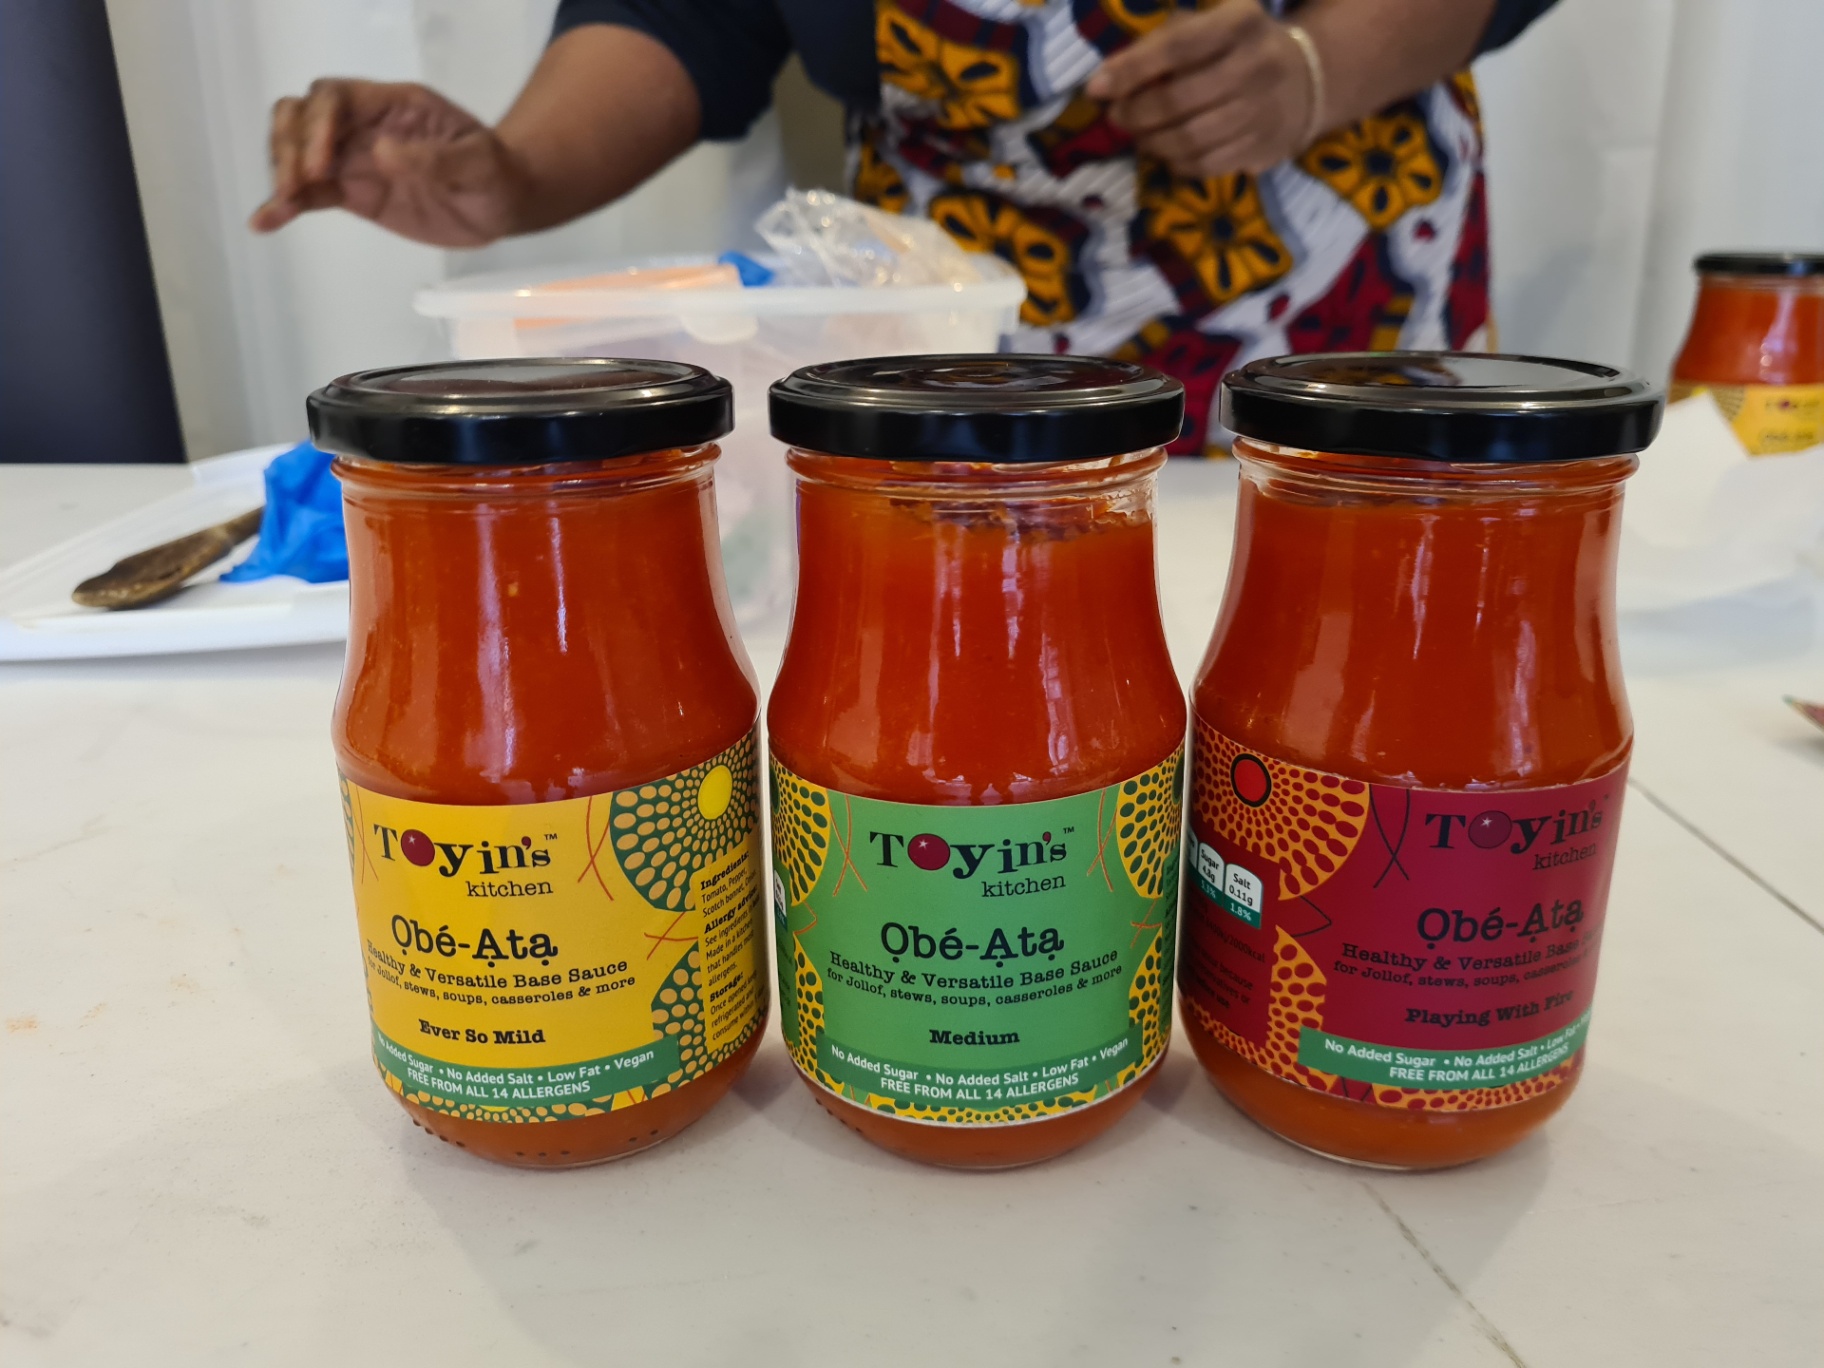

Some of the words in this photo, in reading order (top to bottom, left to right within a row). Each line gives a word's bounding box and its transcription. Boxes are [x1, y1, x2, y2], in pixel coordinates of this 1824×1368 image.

[1201, 849, 1219, 870] Sugar
[1532, 843, 1597, 871] kitchen
[465, 880, 553, 898] kitchen
[981, 875, 1066, 898] kitchen
[1232, 873, 1251, 890] Salt
[702, 899, 724, 918] Scotch
[1229, 884, 1253, 907] 0.11g
[704, 907, 736, 934] Allergy
[1230, 902, 1252, 921] 1.8%
[705, 934, 717, 947] See
[706, 943, 724, 960] Made
[367, 938, 406, 976] Healthy
[409, 963, 422, 979] &
[424, 967, 507, 988] Versatile
[513, 973, 562, 988] Base
[568, 960, 628, 983] Sauce
[707, 959, 721, 973] that
[830, 950, 895, 984] Healthy
[901, 970, 916, 985] &
[921, 972, 1014, 989] Versatile
[1020, 967, 1064, 986] Base
[1070, 950, 1118, 976] Sauce
[1342, 942, 1428, 972] Healthy
[1433, 956, 1451, 971] &
[1458, 951, 1542, 970] Versatile
[377, 965, 402, 989] Jollof,
[404, 981, 440, 1000] stews,
[443, 991, 487, 1006] soups,
[491, 990, 573, 1005] casseroles
[578, 985, 591, 997] &
[596, 976, 636, 994] more
[709, 971, 744, 1002] Storage:
[827, 967, 843, 983] for
[846, 976, 886, 998] Jollof,
[890, 988, 937, 1006] stews,
[941, 995, 991, 1007] soups,
[995, 983, 1073, 1005] casseroles
[1076, 977, 1088, 990] &
[1091, 965, 1122, 985] more
[1333, 960, 1358, 975] for
[1361, 967, 1413, 987] Jollof,
[1418, 975, 1469, 989] stews,
[1473, 974, 1520, 987] soups,
[710, 999, 727, 1015] Once
[1405, 1008, 1491, 1028] Playing
[1496, 1001, 1540, 1022] With
[418, 1018, 460, 1041] Ever
[465, 1028, 489, 1044] So
[493, 1029, 546, 1044] Mild
[929, 1029, 1020, 1045] Medium
[385, 1042, 407, 1062] Added
[407, 1054, 434, 1073] Sugar
[446, 1067, 463, 1080] No
[465, 1071, 505, 1084] Added
[507, 1072, 534, 1085] Salt
[547, 1071, 576, 1083] Low
[579, 1065, 601, 1078] Fat
[614, 1050, 654, 1070] Vegan
[831, 1044, 845, 1060] No
[847, 1052, 880, 1073] Added
[883, 1063, 919, 1081] Sugar
[935, 1073, 954, 1085] No
[957, 1074, 1000, 1086] Added
[1003, 1071, 1029, 1084] Salt
[1042, 1064, 1068, 1078] Low
[1070, 1056, 1089, 1071] Fat
[1100, 1037, 1128, 1060] Vegan
[1324, 1038, 1344, 1054] No
[1347, 1044, 1392, 1063] Added
[1395, 1052, 1436, 1068] Sugar
[1454, 1055, 1473, 1067] No
[1475, 1050, 1516, 1066] Added
[1517, 1045, 1538, 1060] Salt
[1546, 1035, 1564, 1050] Low
[1389, 1066, 1425, 1081] FREE
[1428, 1069, 1469, 1082] FROM
[1471, 1069, 1496, 1080] ALL
[1500, 1066, 1515, 1078] 14
[1516, 1041, 1569, 1074] ALLERGENS
[407, 1067, 430, 1086] FREE
[431, 1076, 463, 1094] FROM
[465, 1085, 489, 1098] ALL
[492, 1087, 508, 1098] 14
[512, 1080, 591, 1099] ALLERGENS
[880, 1077, 911, 1094] FREE
[914, 1083, 952, 1099] FROM
[956, 1089, 982, 1100] ALL
[985, 1089, 1003, 1099] 14
[1006, 1072, 1079, 1098] ALLERGENS
